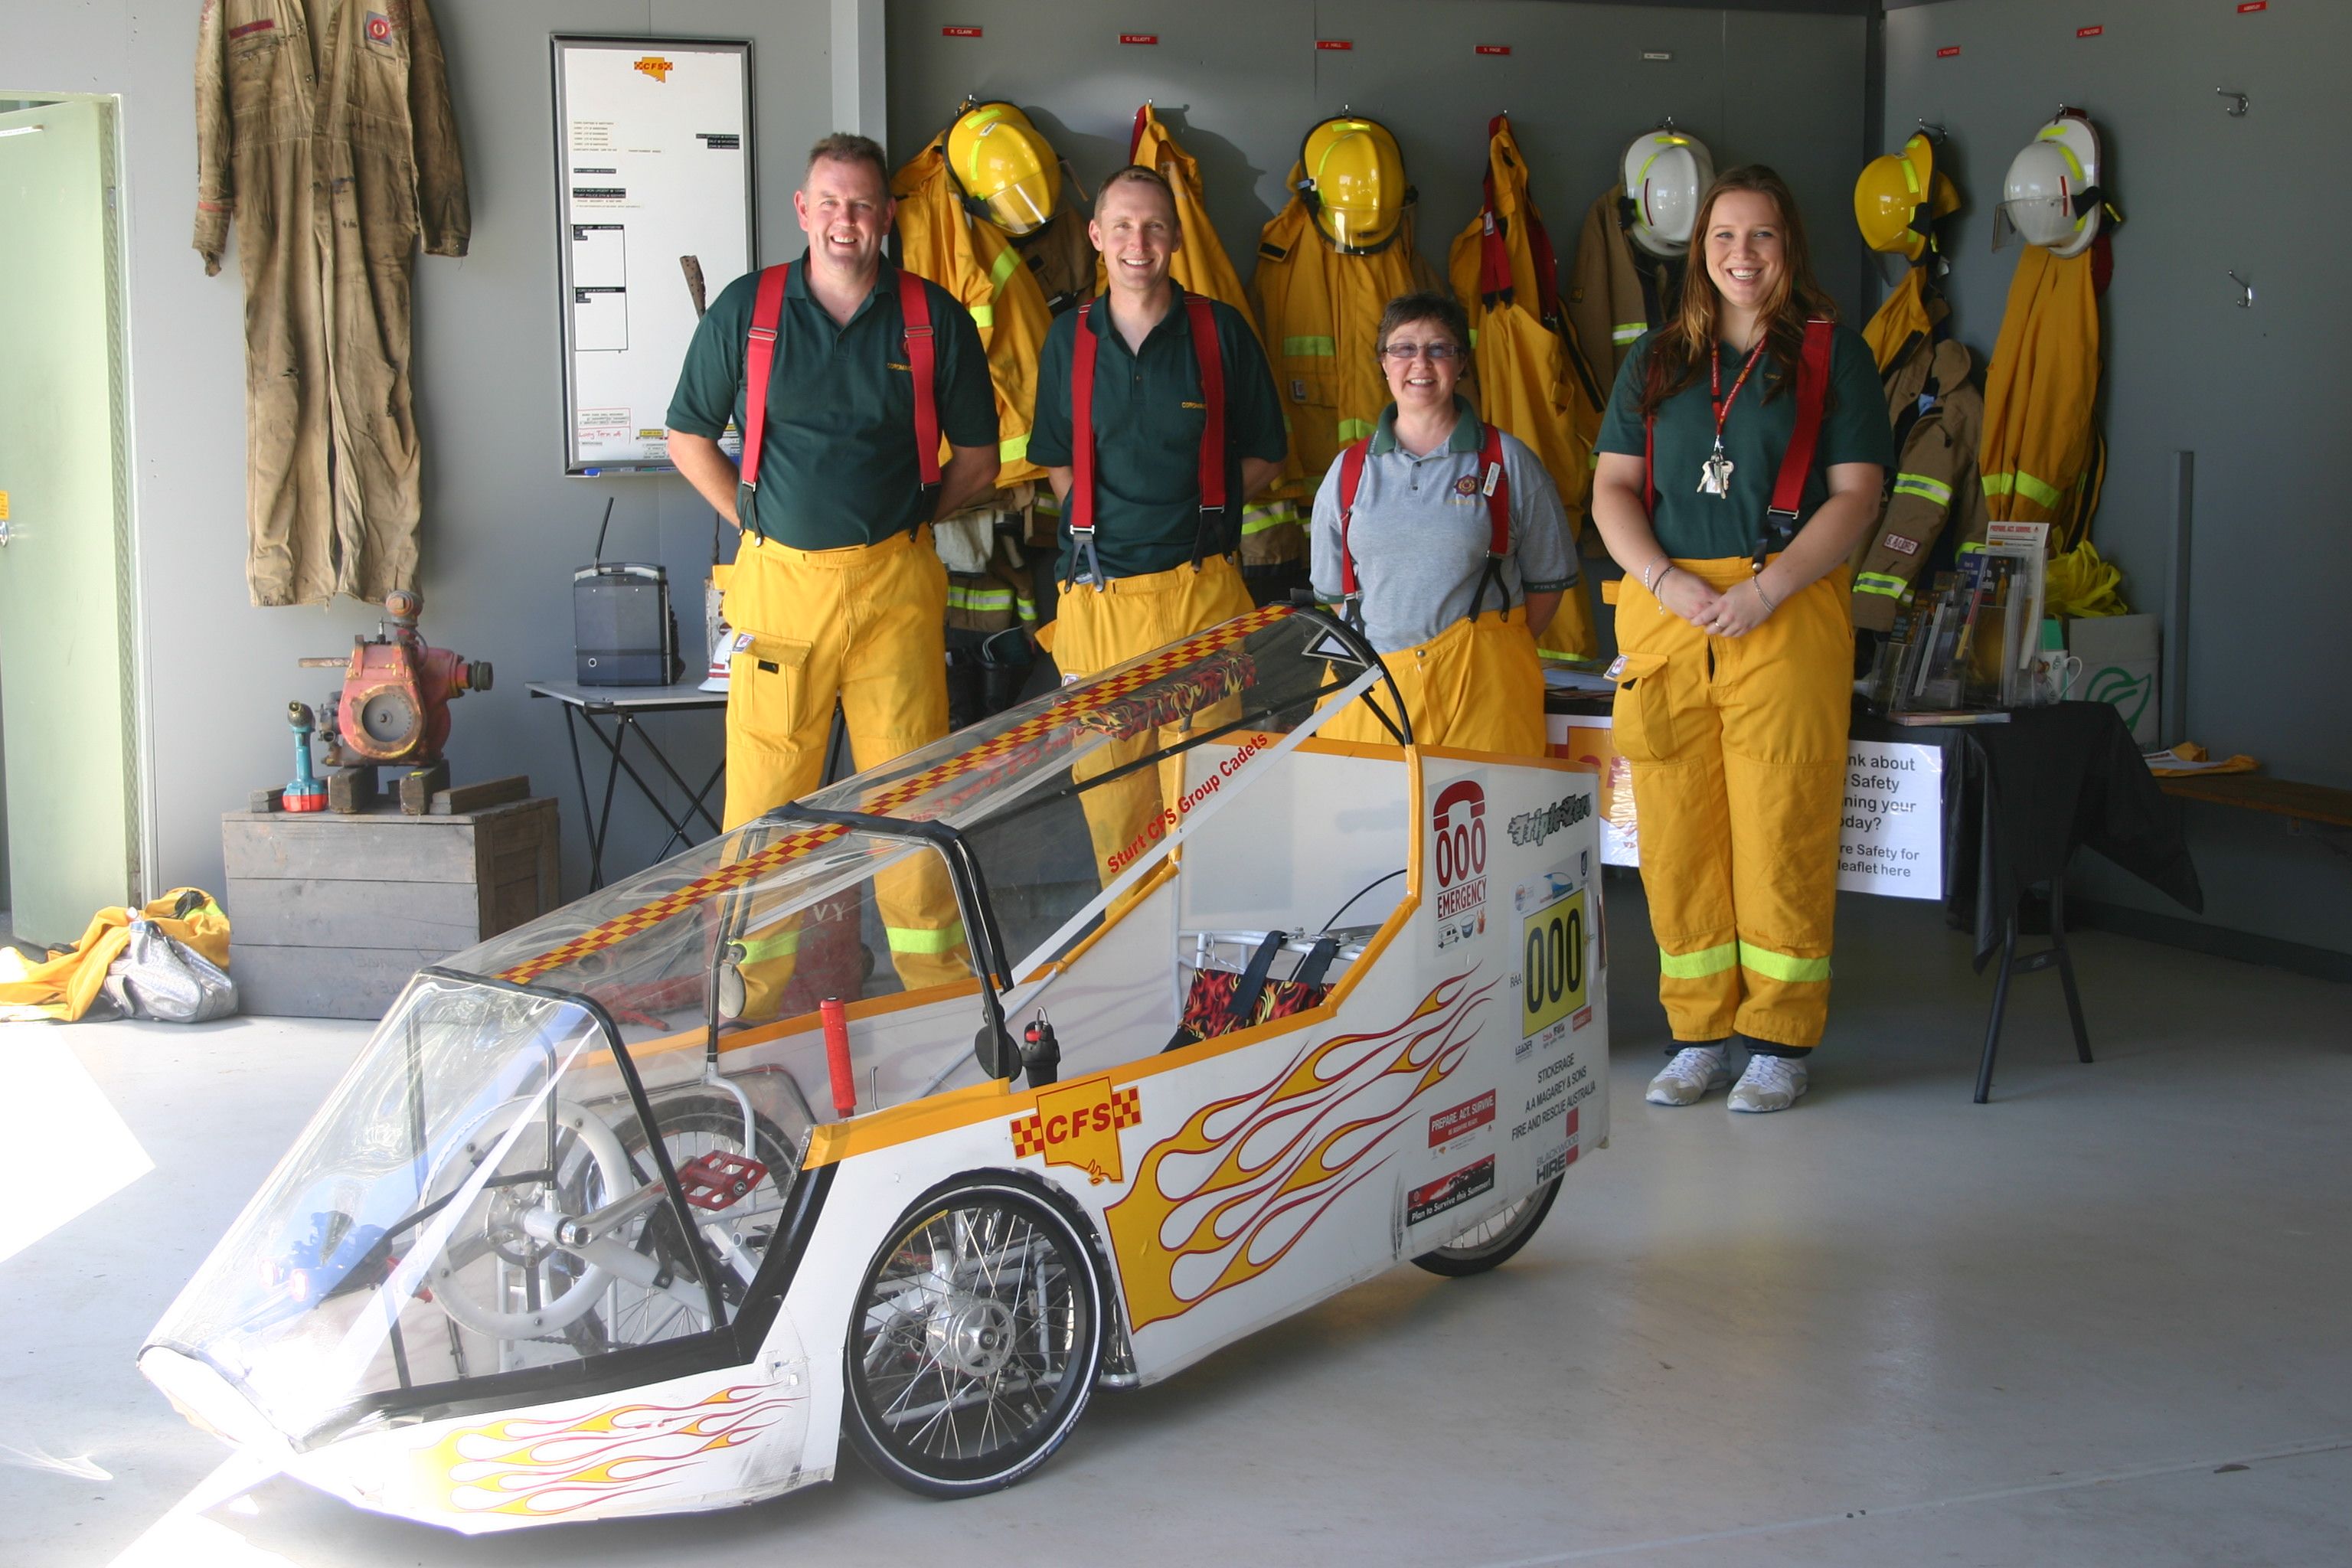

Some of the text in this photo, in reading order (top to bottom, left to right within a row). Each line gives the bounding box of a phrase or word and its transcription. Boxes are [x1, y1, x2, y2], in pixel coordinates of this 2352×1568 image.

[1870, 756, 1916, 771] about
[1851, 773, 1900, 793] Safety
[1107, 733, 1268, 874] Sturt CFS Group Cadets
[1881, 800, 1916, 814] your
[1436, 818, 1487, 887] 000
[1838, 859, 1911, 877] leaflet here
[1857, 844, 1897, 861] Safety
[1901, 848, 1920, 861] for
[1437, 878, 1487, 919] EMERGENCY
[1527, 908, 1581, 1014] 000
[1510, 973, 1523, 988] RAA
[1515, 1040, 1533, 1056] LEADER
[1537, 1053, 1575, 1083] STICKERAGE
[1537, 1080, 1566, 1107] MAGAREY
[1566, 1075, 1571, 1088] &
[1571, 1066, 1587, 1085] SONS
[1046, 1102, 1111, 1145] CFS
[1511, 1080, 1596, 1141] FIRE AND RESCUE AUSTRALIA
[1537, 1133, 1579, 1166] BLACKWOOD
[1536, 1152, 1566, 1185] HIRE
[1411, 1210, 1425, 1222] Plan
[1426, 1207, 1433, 1215] to
[1433, 1197, 1455, 1212] Survive
[1456, 1190, 1467, 1201] this
